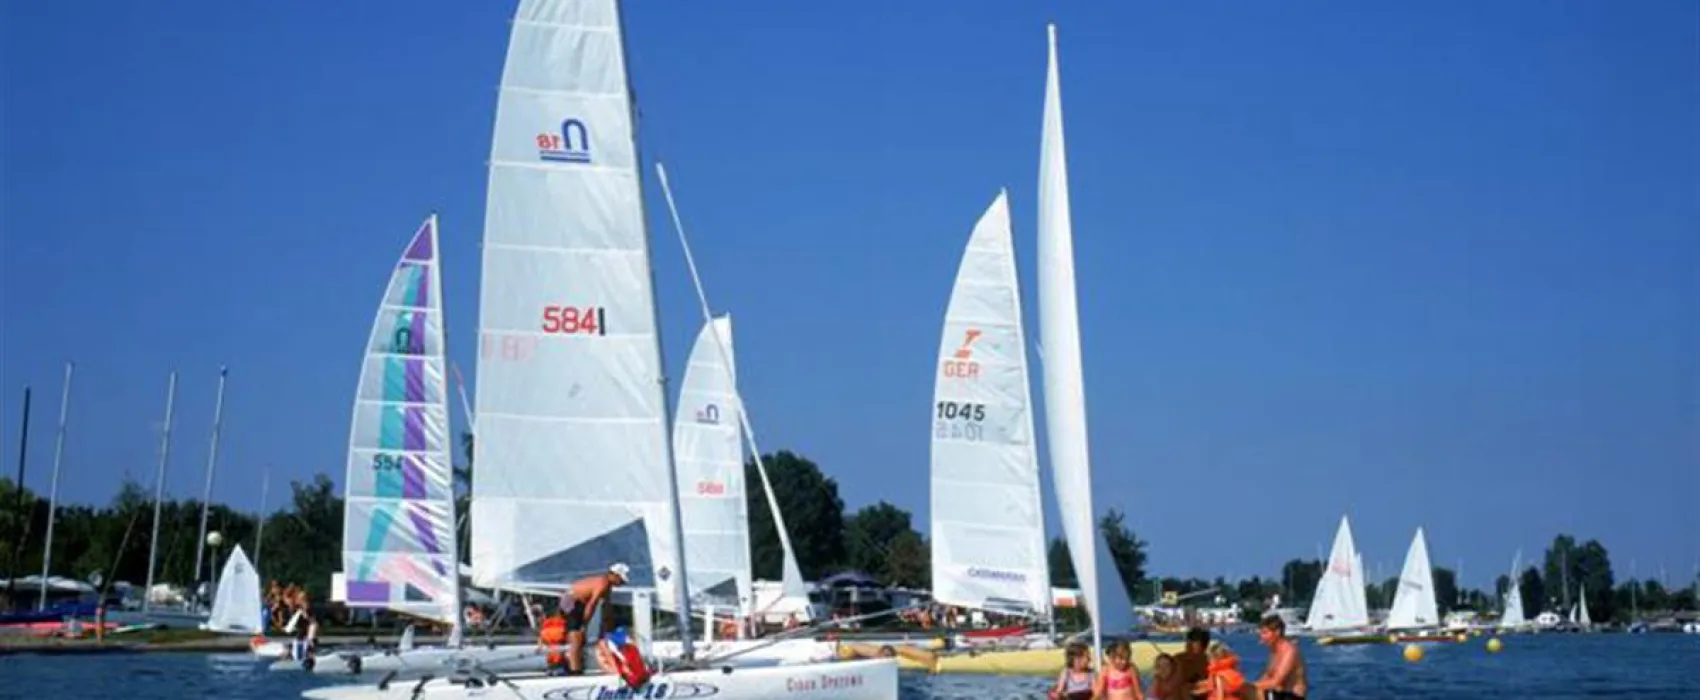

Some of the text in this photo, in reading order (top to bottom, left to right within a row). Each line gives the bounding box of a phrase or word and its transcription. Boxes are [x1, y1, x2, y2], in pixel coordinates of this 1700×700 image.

[542, 306, 605, 335] 5841
[943, 361, 980, 378] GER
[936, 400, 985, 421] 1045
